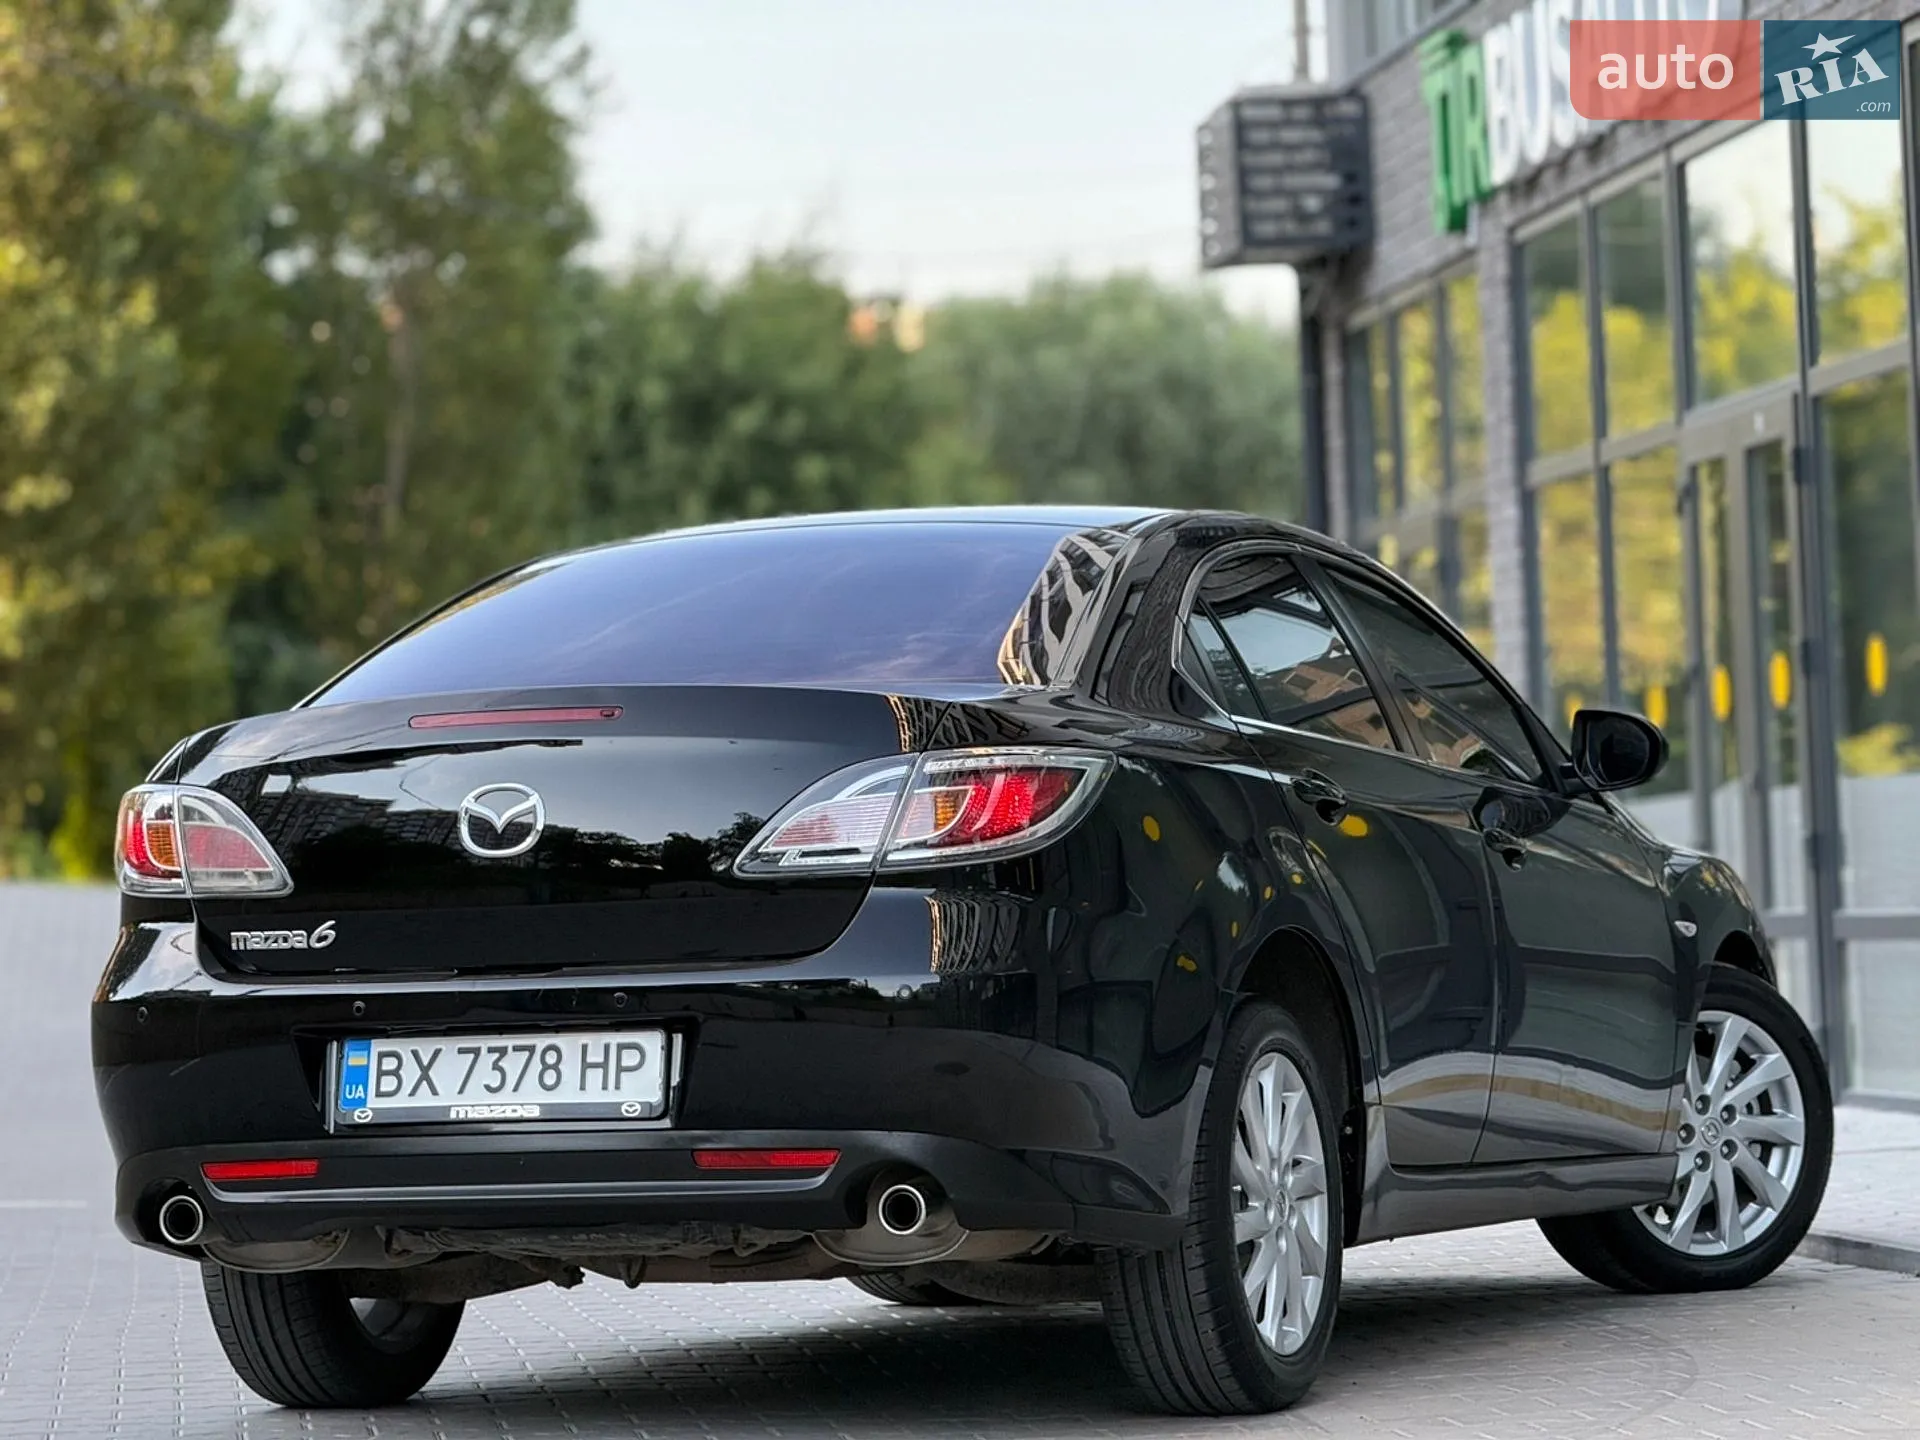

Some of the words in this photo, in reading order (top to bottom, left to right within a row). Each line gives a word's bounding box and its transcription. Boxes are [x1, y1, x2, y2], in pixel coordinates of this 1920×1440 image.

[374, 1047, 443, 1099] BX
[456, 1043, 563, 1096] 7378
[578, 1041, 648, 1093] HP
[345, 1084, 366, 1100] UA
